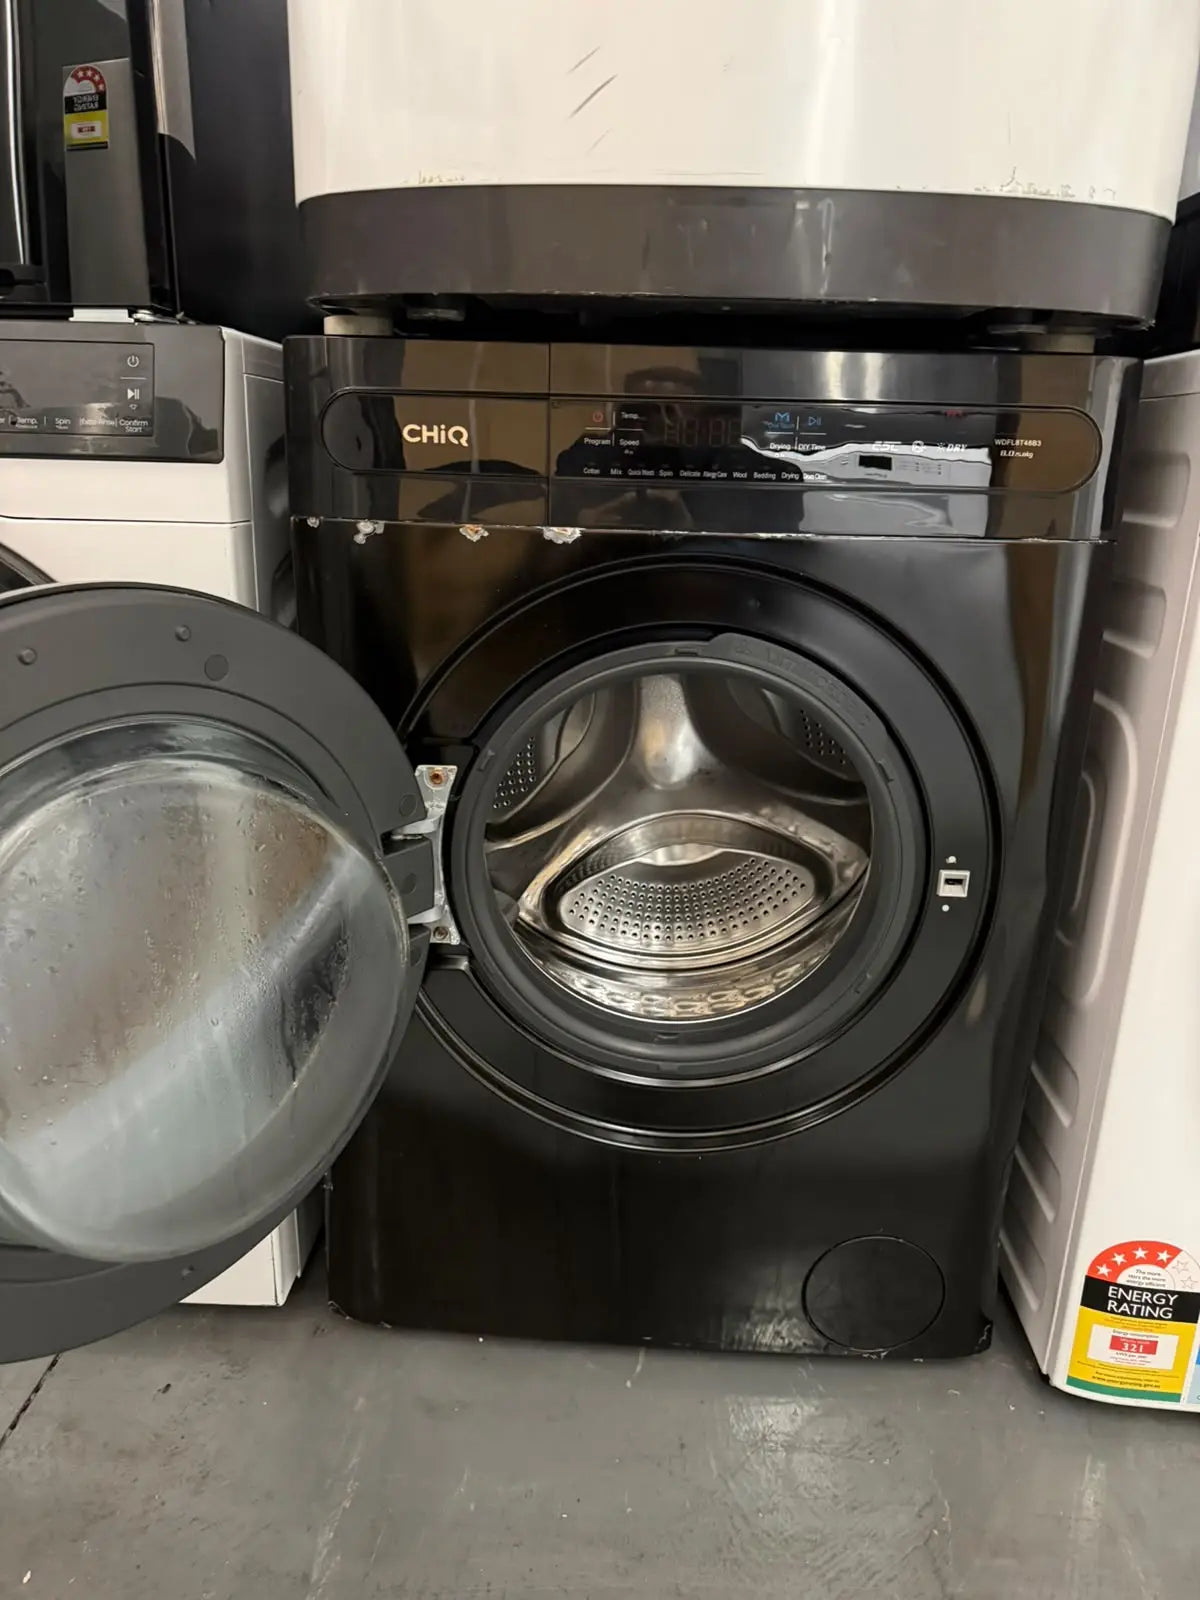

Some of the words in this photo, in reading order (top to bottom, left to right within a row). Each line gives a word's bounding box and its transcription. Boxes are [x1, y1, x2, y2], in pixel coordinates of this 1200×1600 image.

[55, 418, 71, 426] Spin
[119, 419, 149, 427] Confirm
[402, 423, 469, 447] CHiQ
[584, 437, 611, 446] Program
[620, 438, 640, 447] Speed
[769, 442, 791, 451] Drying
[946, 443, 968, 452] DRY
[583, 467, 600, 475] Cotton
[659, 469, 674, 477] Spin
[753, 472, 776, 480] Bedding
[781, 472, 800, 480] Drying
[1108, 1285, 1179, 1306] ENERGY
[1107, 1299, 1174, 1319] RATING
[1121, 1342, 1144, 1353] 321
